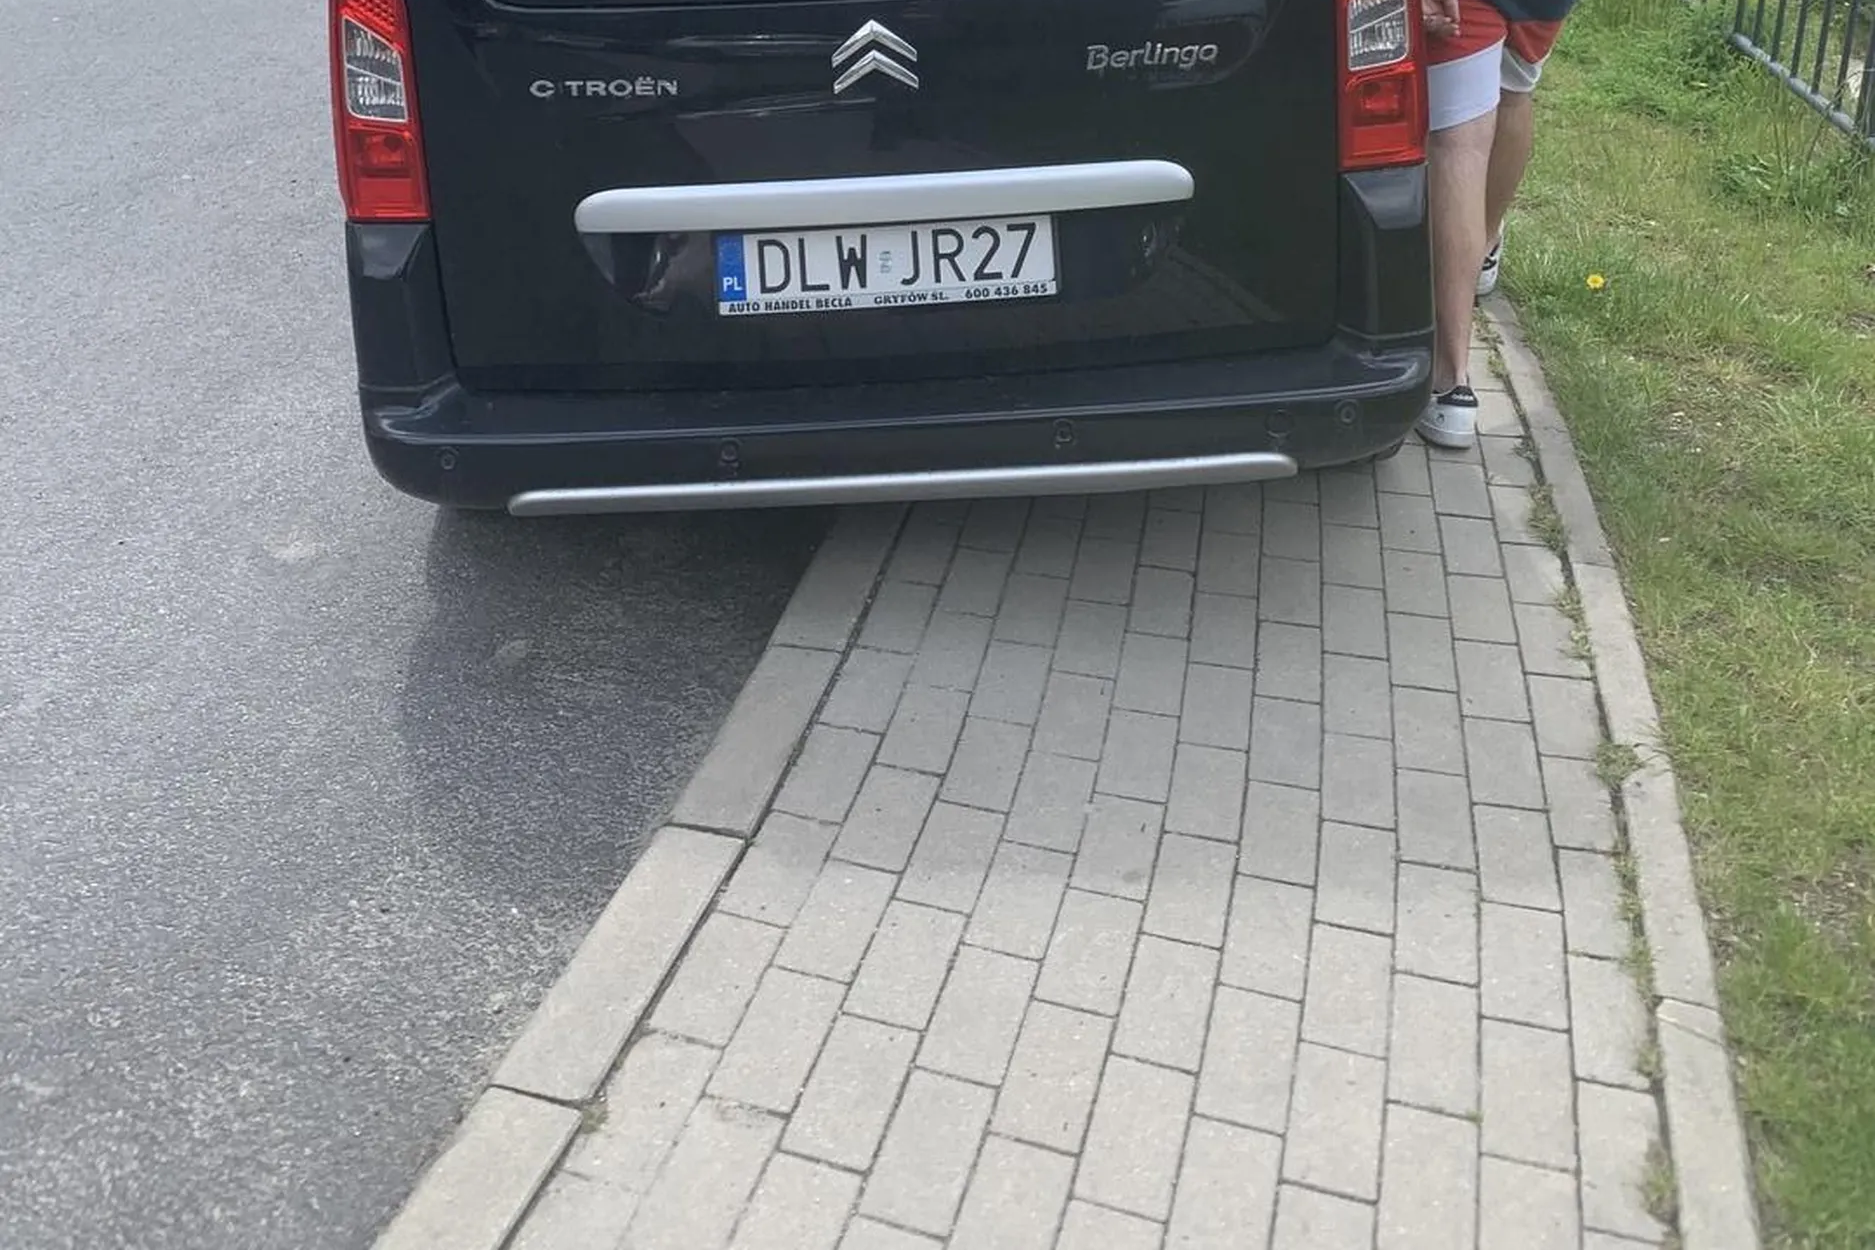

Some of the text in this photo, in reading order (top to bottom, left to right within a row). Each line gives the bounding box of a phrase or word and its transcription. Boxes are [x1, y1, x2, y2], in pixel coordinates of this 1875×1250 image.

[1086, 41, 1218, 70] Berlingo
[757, 222, 1037, 294] DLW JR27
[722, 277, 744, 292] PL
[728, 302, 760, 313] AUTO
[764, 299, 811, 311] HANDEL
[874, 291, 928, 304] GRYFÓW
[965, 288, 990, 299] 600
[994, 285, 1019, 296] 436
[1023, 283, 1048, 294] 845
